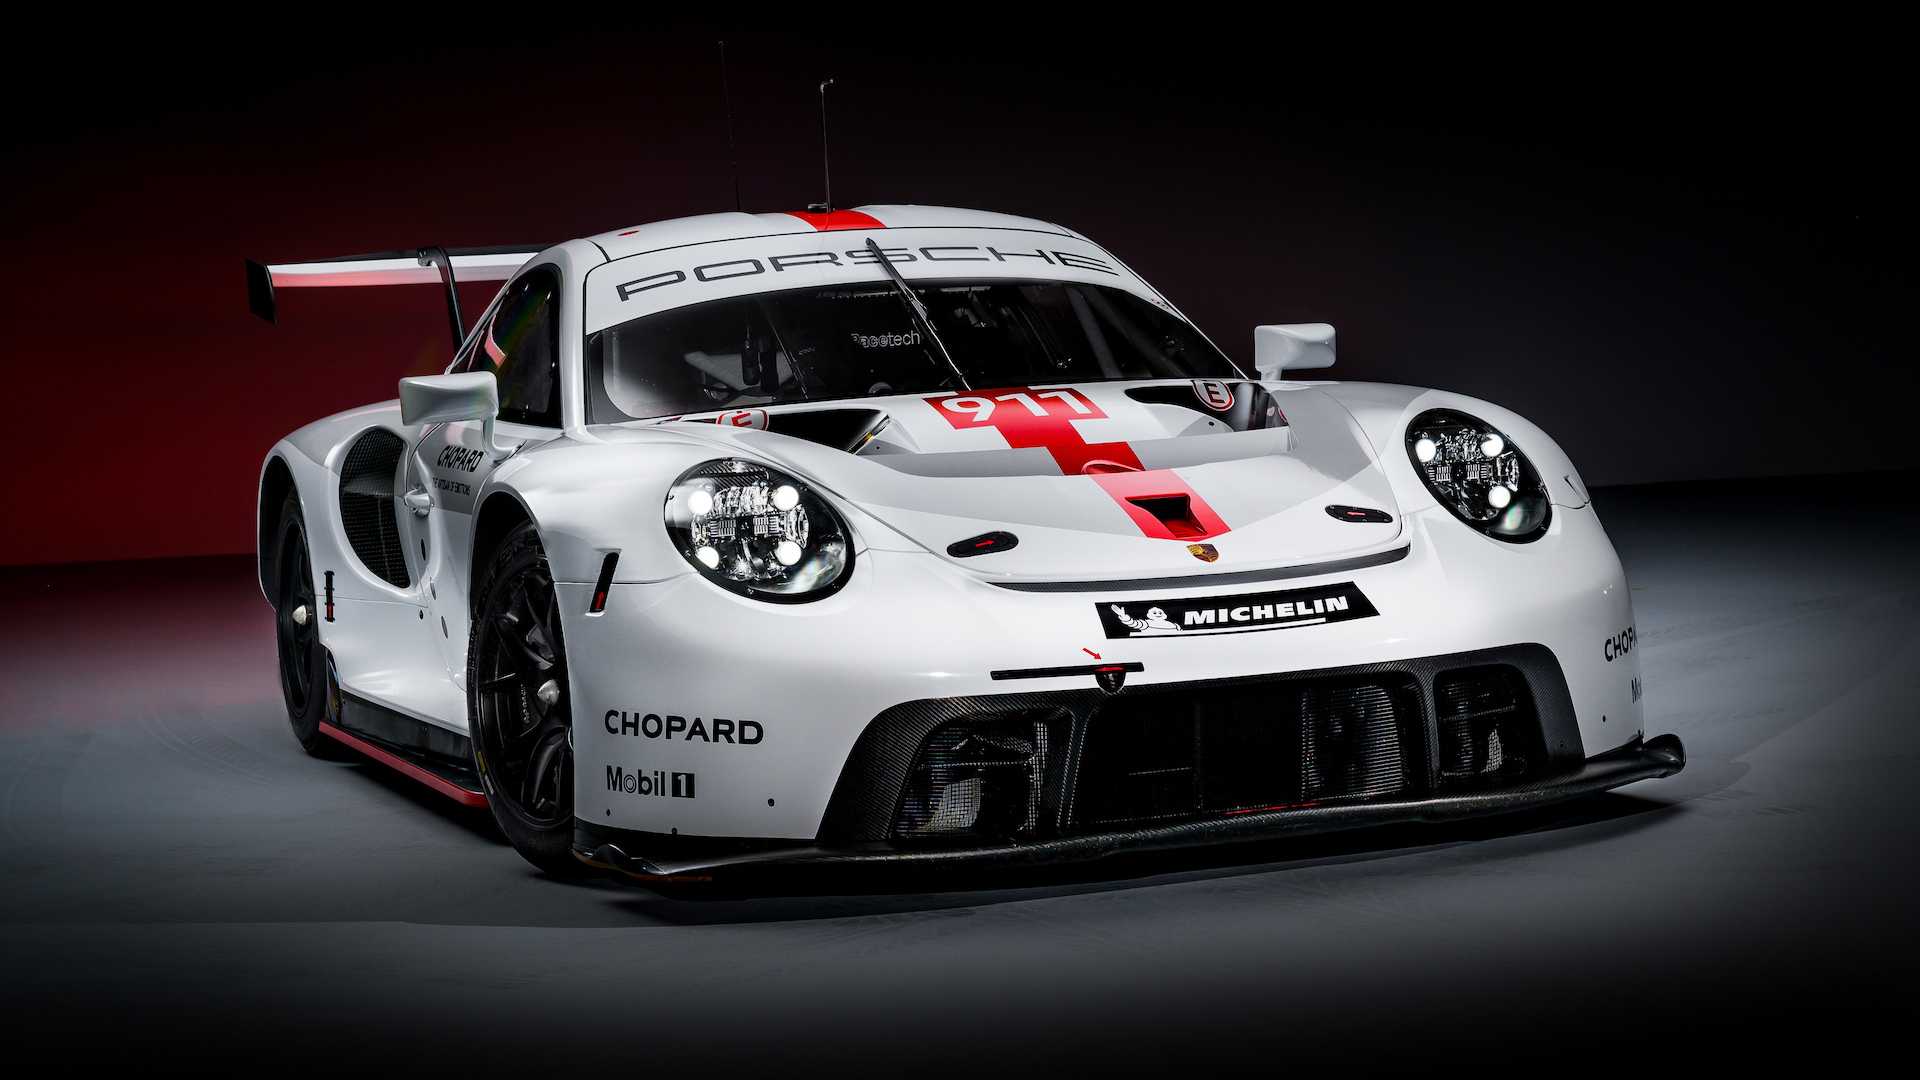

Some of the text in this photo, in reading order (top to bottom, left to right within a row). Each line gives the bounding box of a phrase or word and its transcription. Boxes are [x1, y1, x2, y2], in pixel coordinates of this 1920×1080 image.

[616, 246, 1119, 302] PORSCHE
[941, 390, 1092, 423] 911
[1203, 382, 1226, 404] E
[437, 445, 484, 473] CHOPARD
[1183, 596, 1349, 626] MICHELIN
[604, 709, 764, 745] CHOPARD
[606, 765, 666, 797] Mobil
